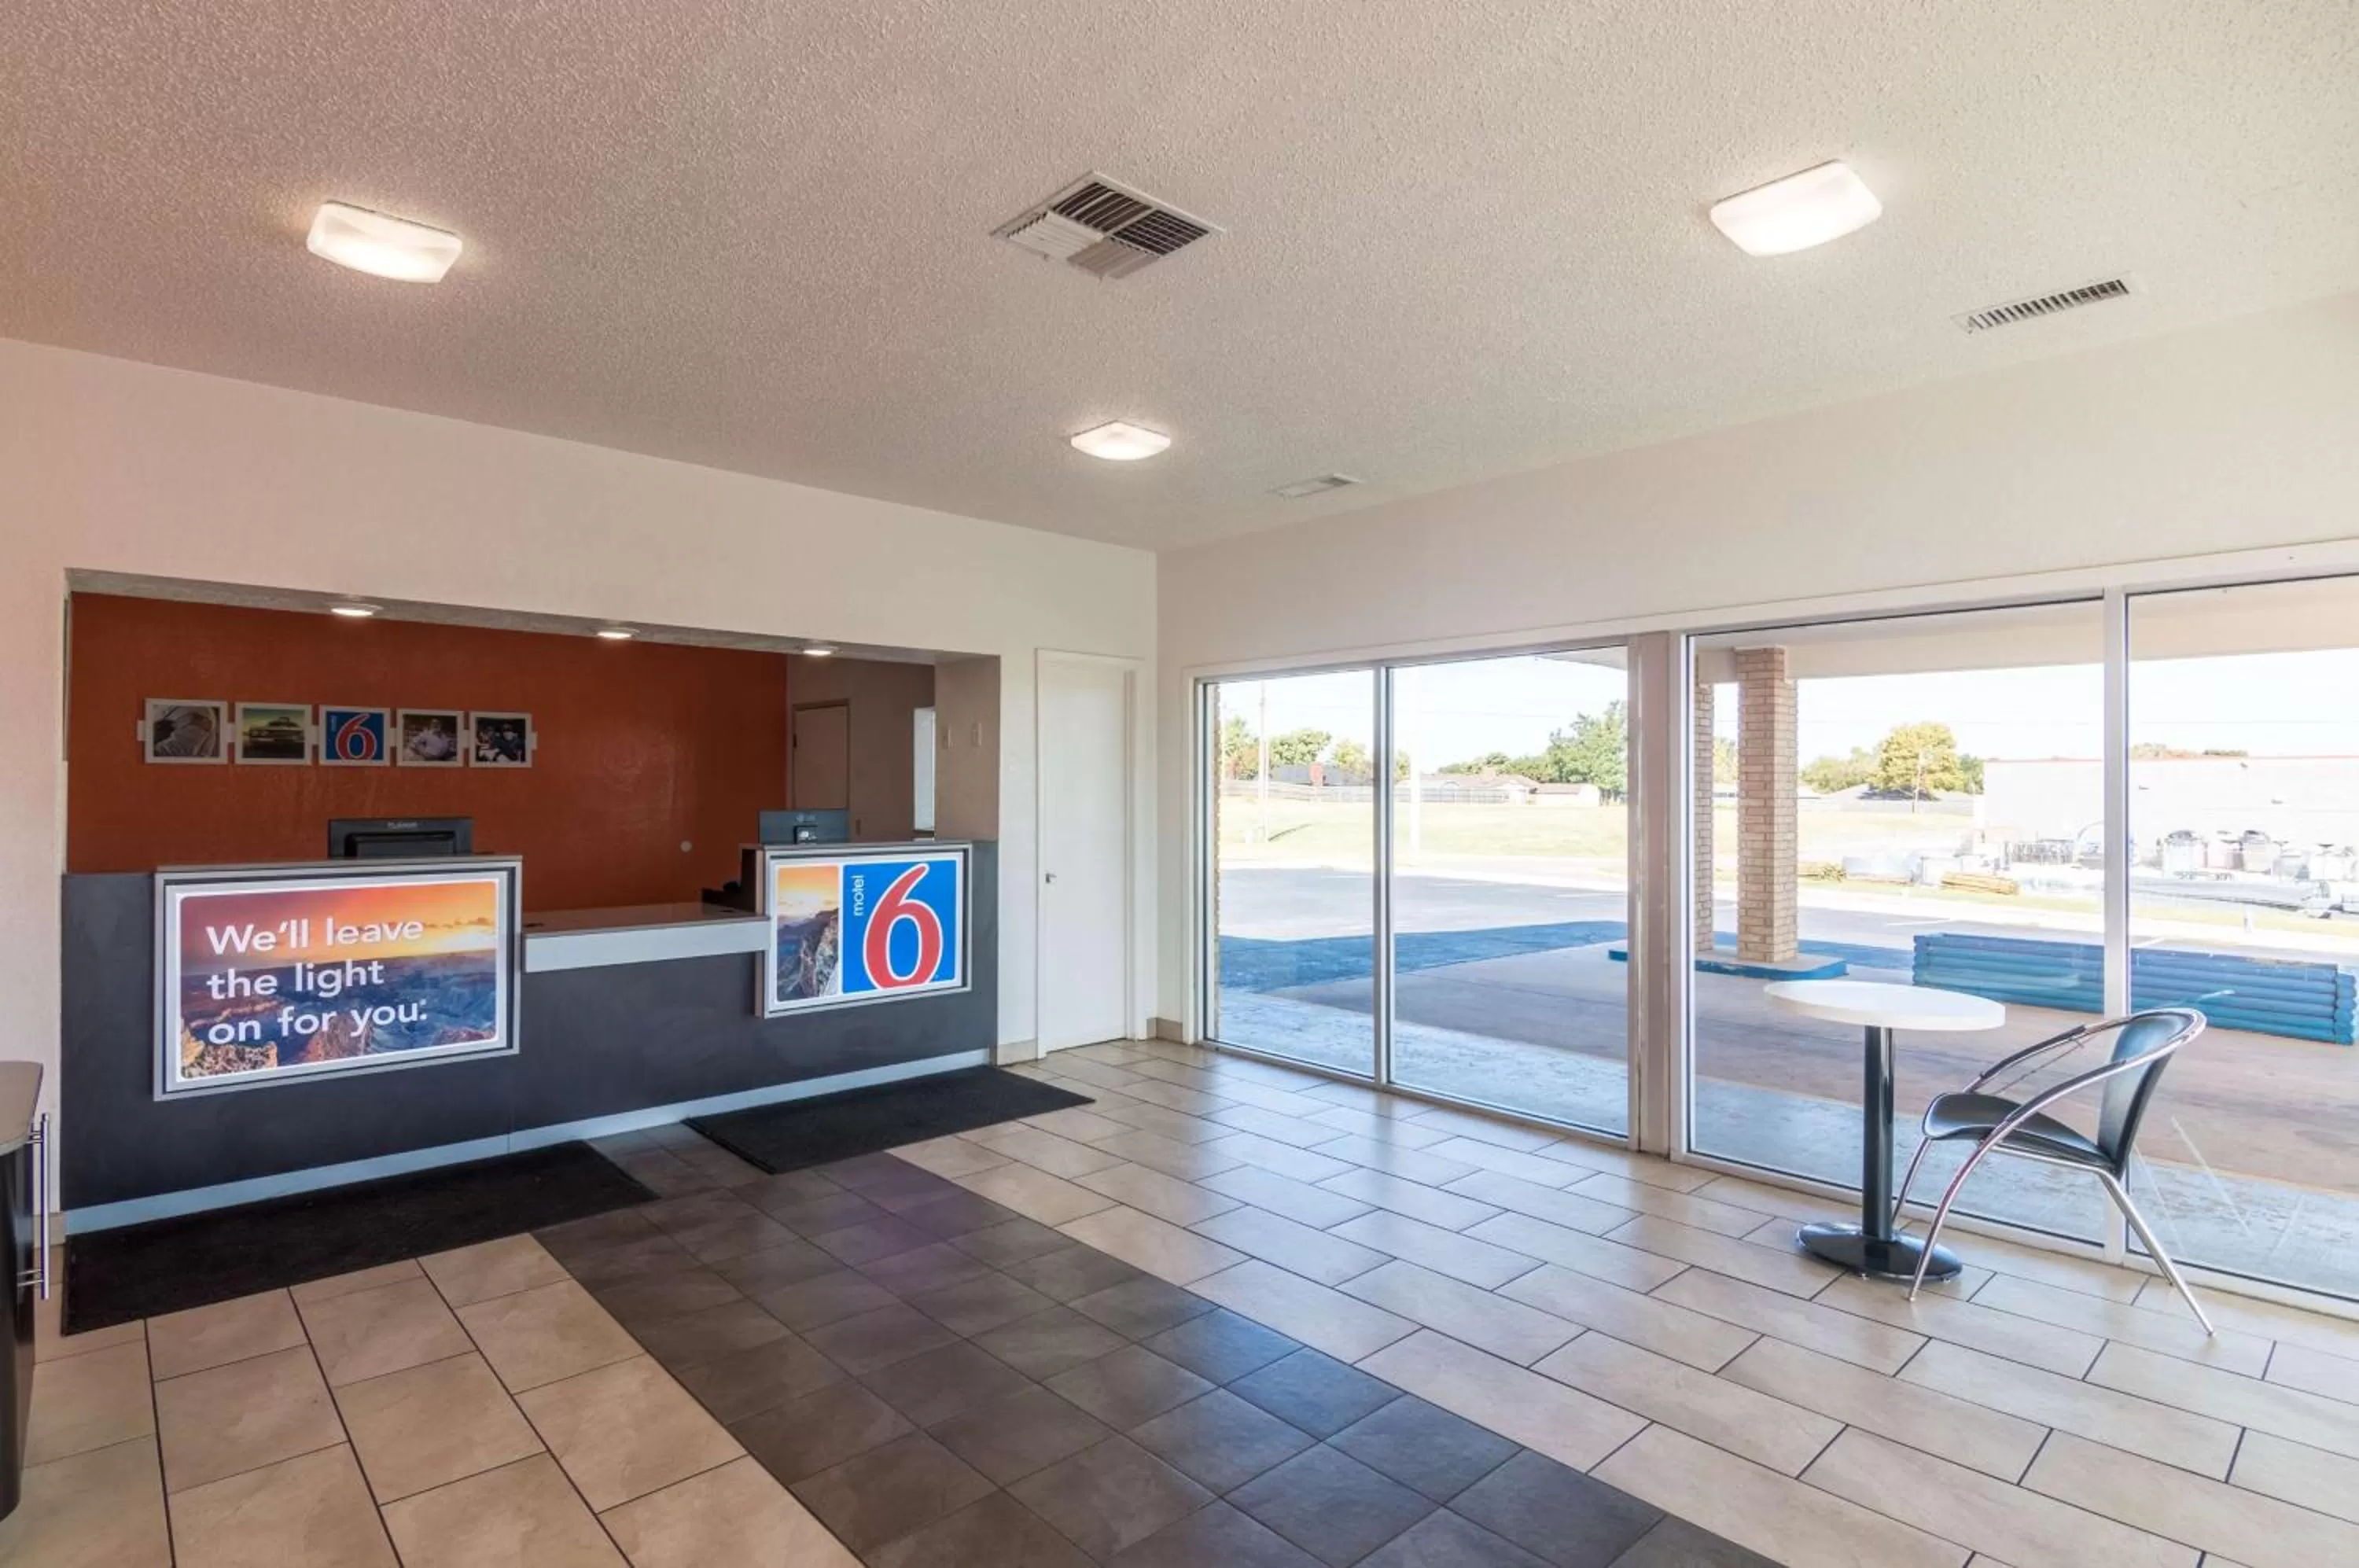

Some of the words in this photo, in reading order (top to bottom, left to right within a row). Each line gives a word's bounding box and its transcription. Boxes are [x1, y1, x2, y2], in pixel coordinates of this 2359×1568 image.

[335, 713, 377, 761] 6
[851, 874, 864, 917] motel
[205, 918, 309, 955] We'll
[326, 916, 424, 946] leave
[863, 863, 943, 990] 6
[206, 968, 278, 1000] the
[295, 959, 385, 998] light
[208, 1019, 261, 1045] on
[278, 1005, 338, 1037] for
[350, 1002, 428, 1037] you.
